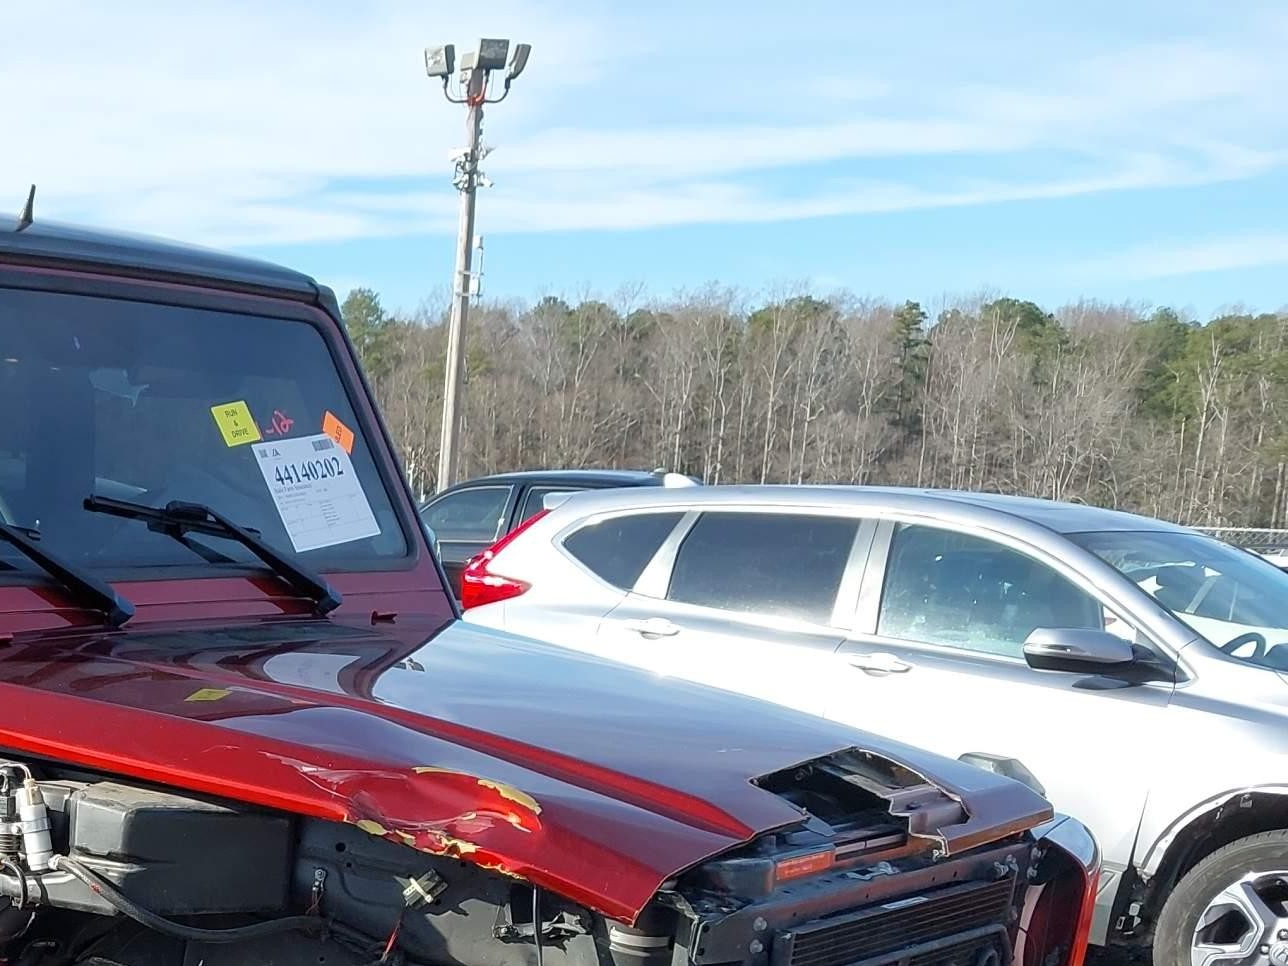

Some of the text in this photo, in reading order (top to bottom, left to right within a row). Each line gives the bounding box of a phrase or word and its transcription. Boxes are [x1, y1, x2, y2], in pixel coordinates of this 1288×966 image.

[224, 408, 238, 418] RUN
[231, 428, 249, 438] DRIVE
[274, 456, 344, 486] 44140202
